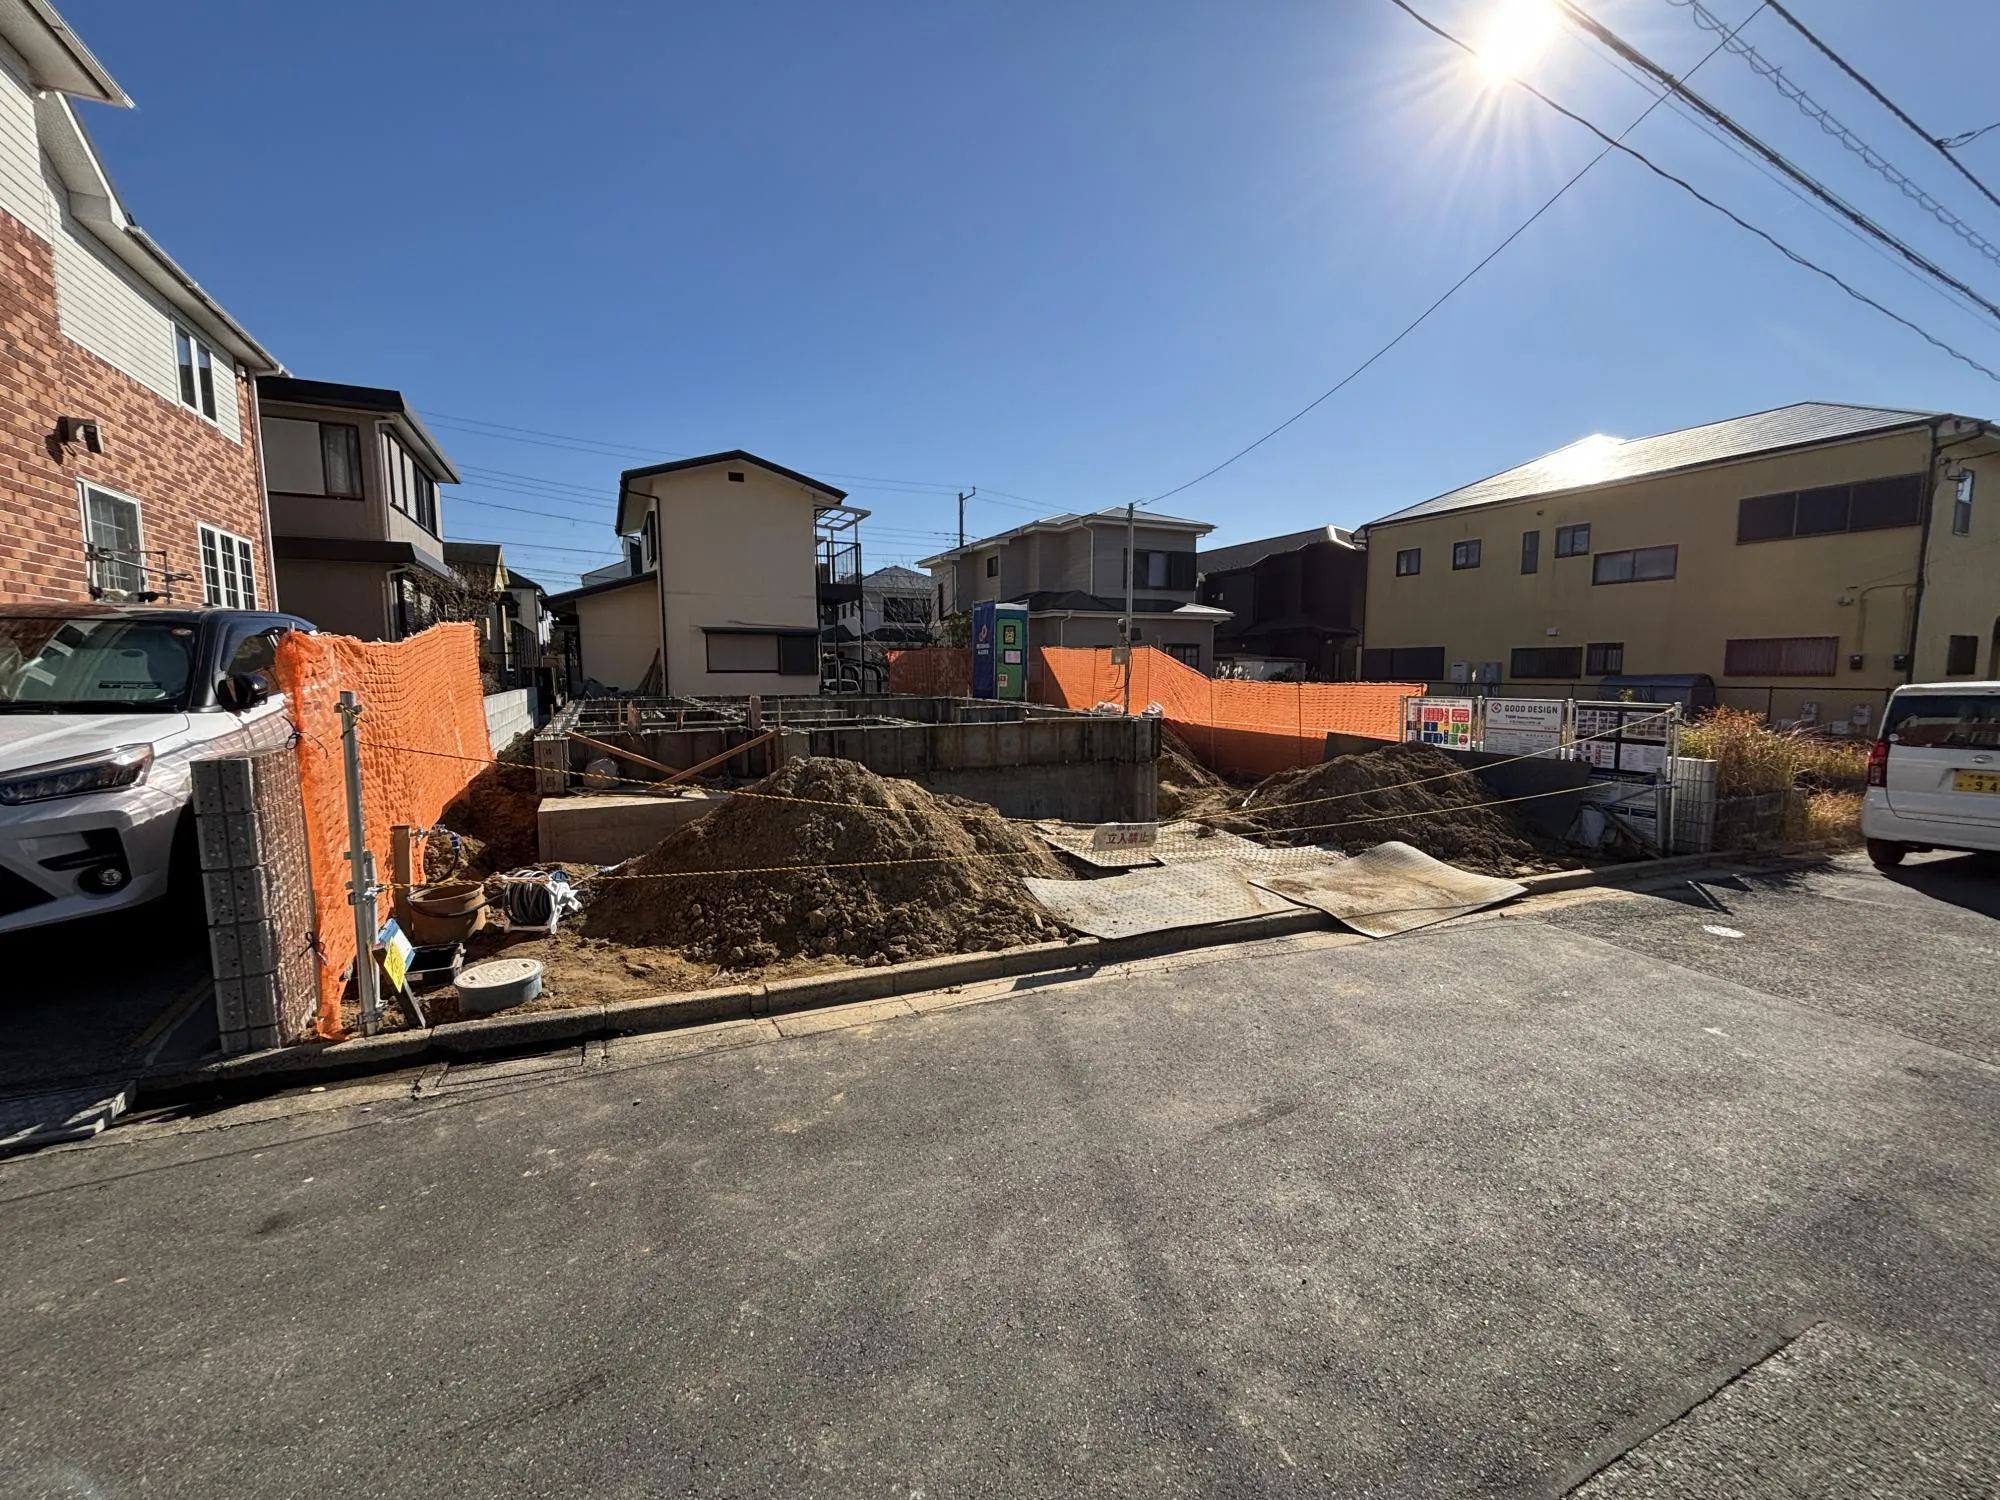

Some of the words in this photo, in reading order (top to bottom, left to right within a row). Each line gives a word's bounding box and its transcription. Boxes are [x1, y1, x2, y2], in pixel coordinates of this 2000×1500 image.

[1504, 704, 1526, 713] GOOD
[1527, 705, 1558, 714] DESIGN
[1105, 831, 1150, 845] 立入禁止
